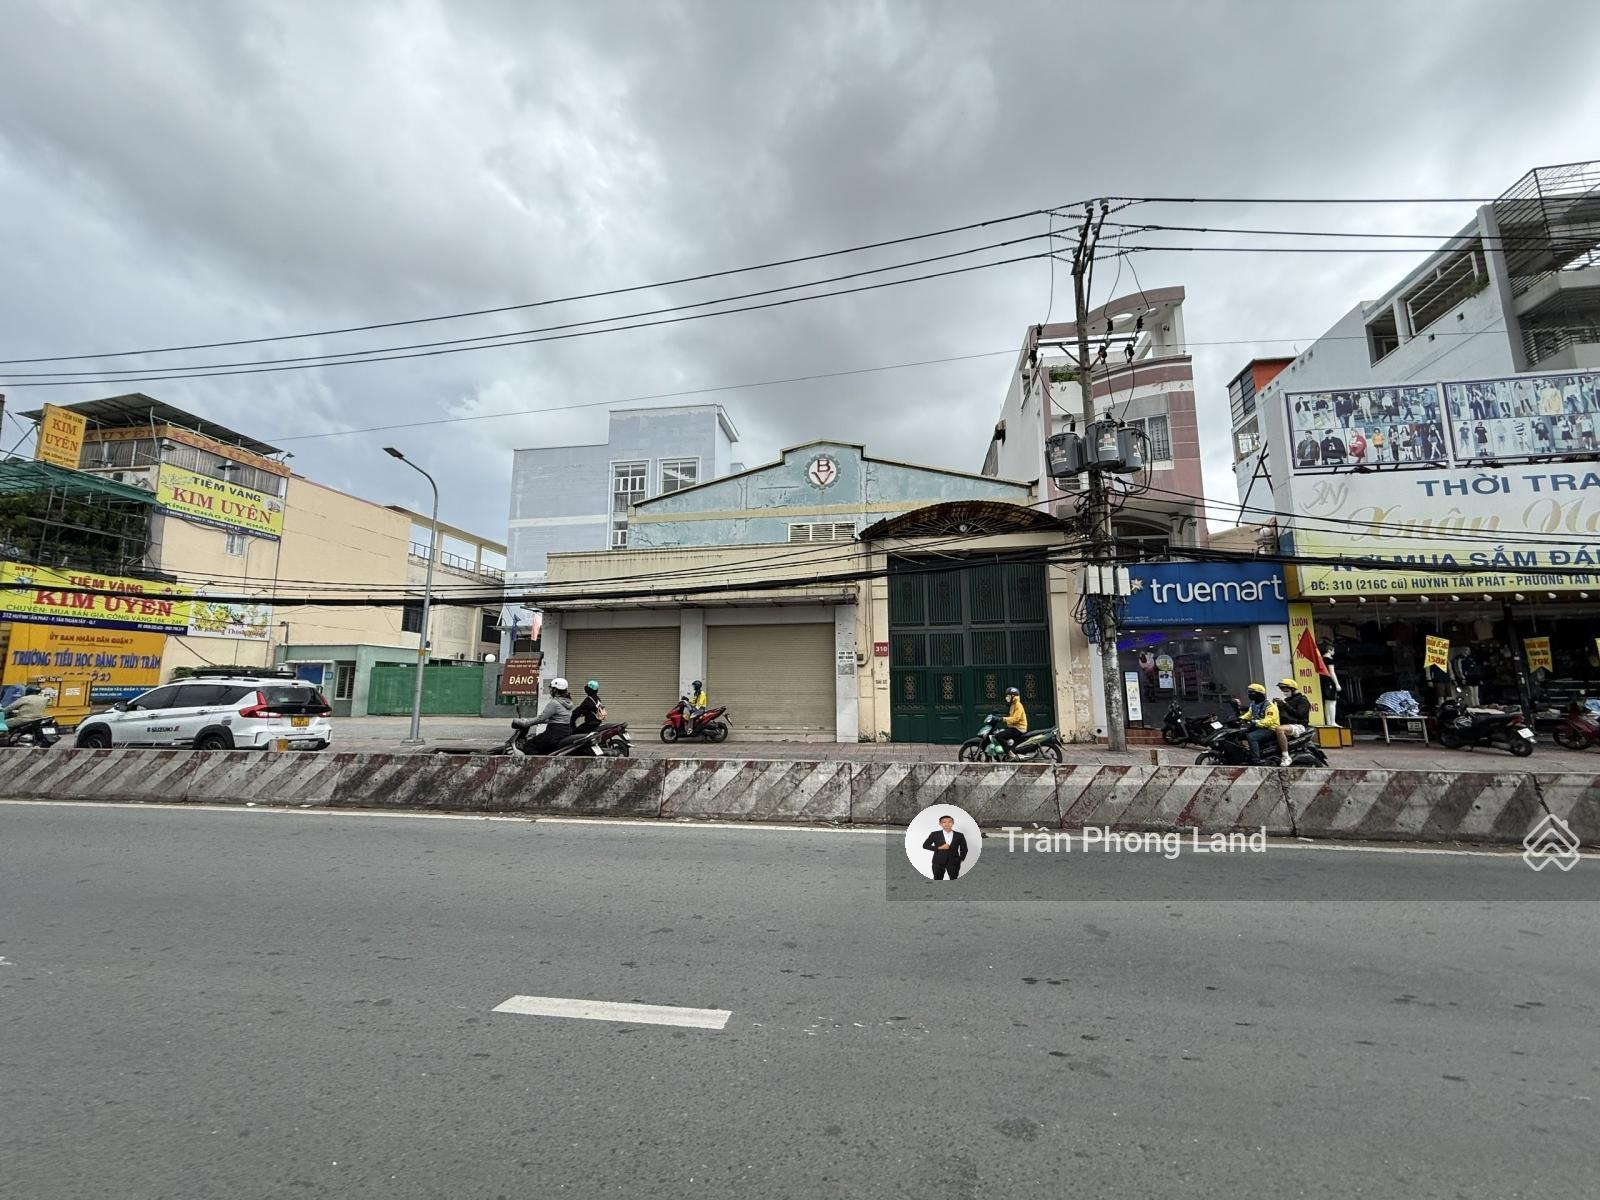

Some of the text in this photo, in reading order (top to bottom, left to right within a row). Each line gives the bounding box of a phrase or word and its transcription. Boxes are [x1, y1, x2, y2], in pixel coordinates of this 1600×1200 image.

[52, 418, 78, 436] KIM
[45, 432, 79, 452] UYÊN
[817, 459, 831, 472] B
[192, 476, 261, 502] TIỆM VÀNG
[1416, 473, 1511, 497] THỜI
[172, 485, 272, 524] KIM UYÊN
[1347, 504, 1501, 542] Xuân
[1468, 545, 1537, 569] SẮM
[109, 578, 143, 593] VÀNG
[1150, 574, 1284, 604] truemart
[1311, 580, 1330, 591] ĐC:
[1332, 579, 1352, 591] 310
[1356, 578, 1388, 592] (216C
[1391, 577, 1408, 590] cũ)
[33, 590, 95, 610] KIM
[50, 607, 70, 615] MUA
[72, 609, 89, 618] BÁN
[90, 611, 105, 619] GIA
[130, 613, 152, 622] VÀNG
[75, 634, 95, 643] NHÂN
[12, 648, 51, 666] TRƯỜNG
[75, 652, 94, 670] HỌC
[509, 675, 534, 686] ĐẶNG
